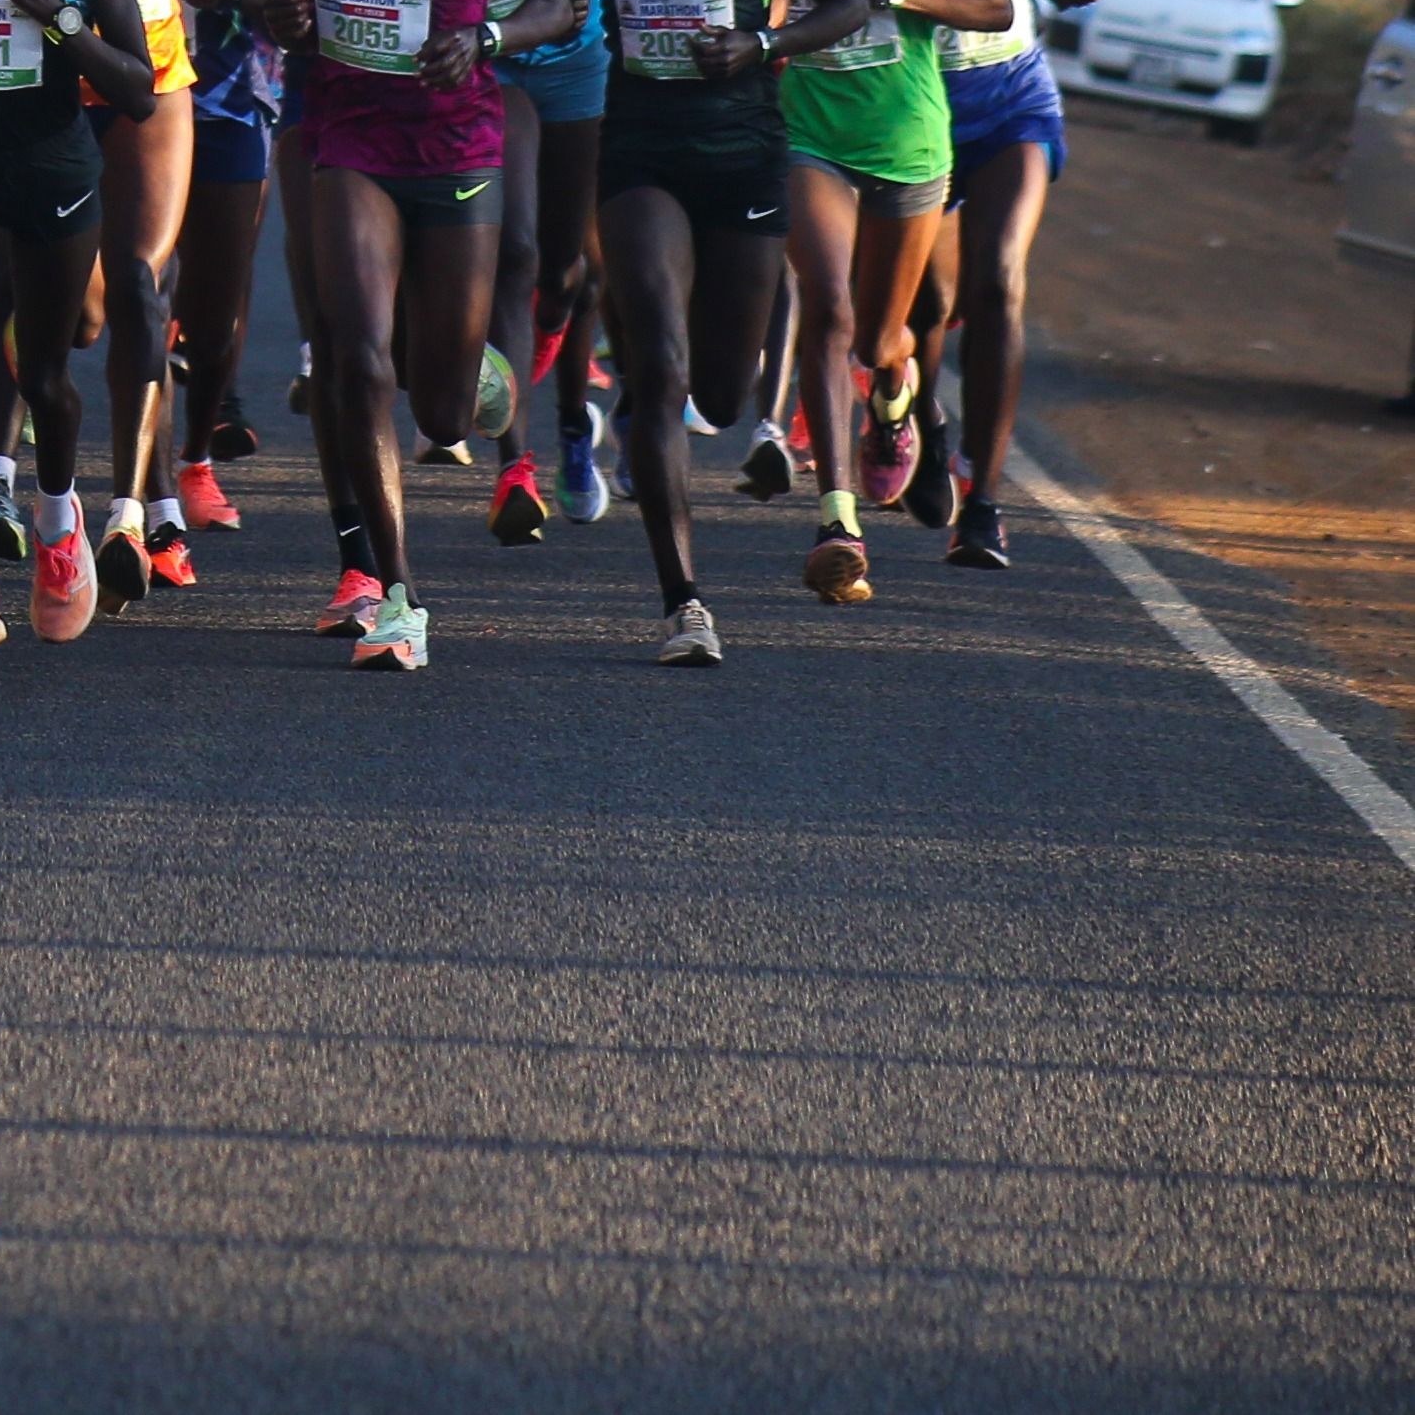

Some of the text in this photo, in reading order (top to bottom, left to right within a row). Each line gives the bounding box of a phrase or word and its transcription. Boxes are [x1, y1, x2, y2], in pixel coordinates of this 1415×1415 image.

[639, 4, 701, 17] MARATHON
[334, 14, 401, 50] 2055
[639, 31, 704, 58] 203
